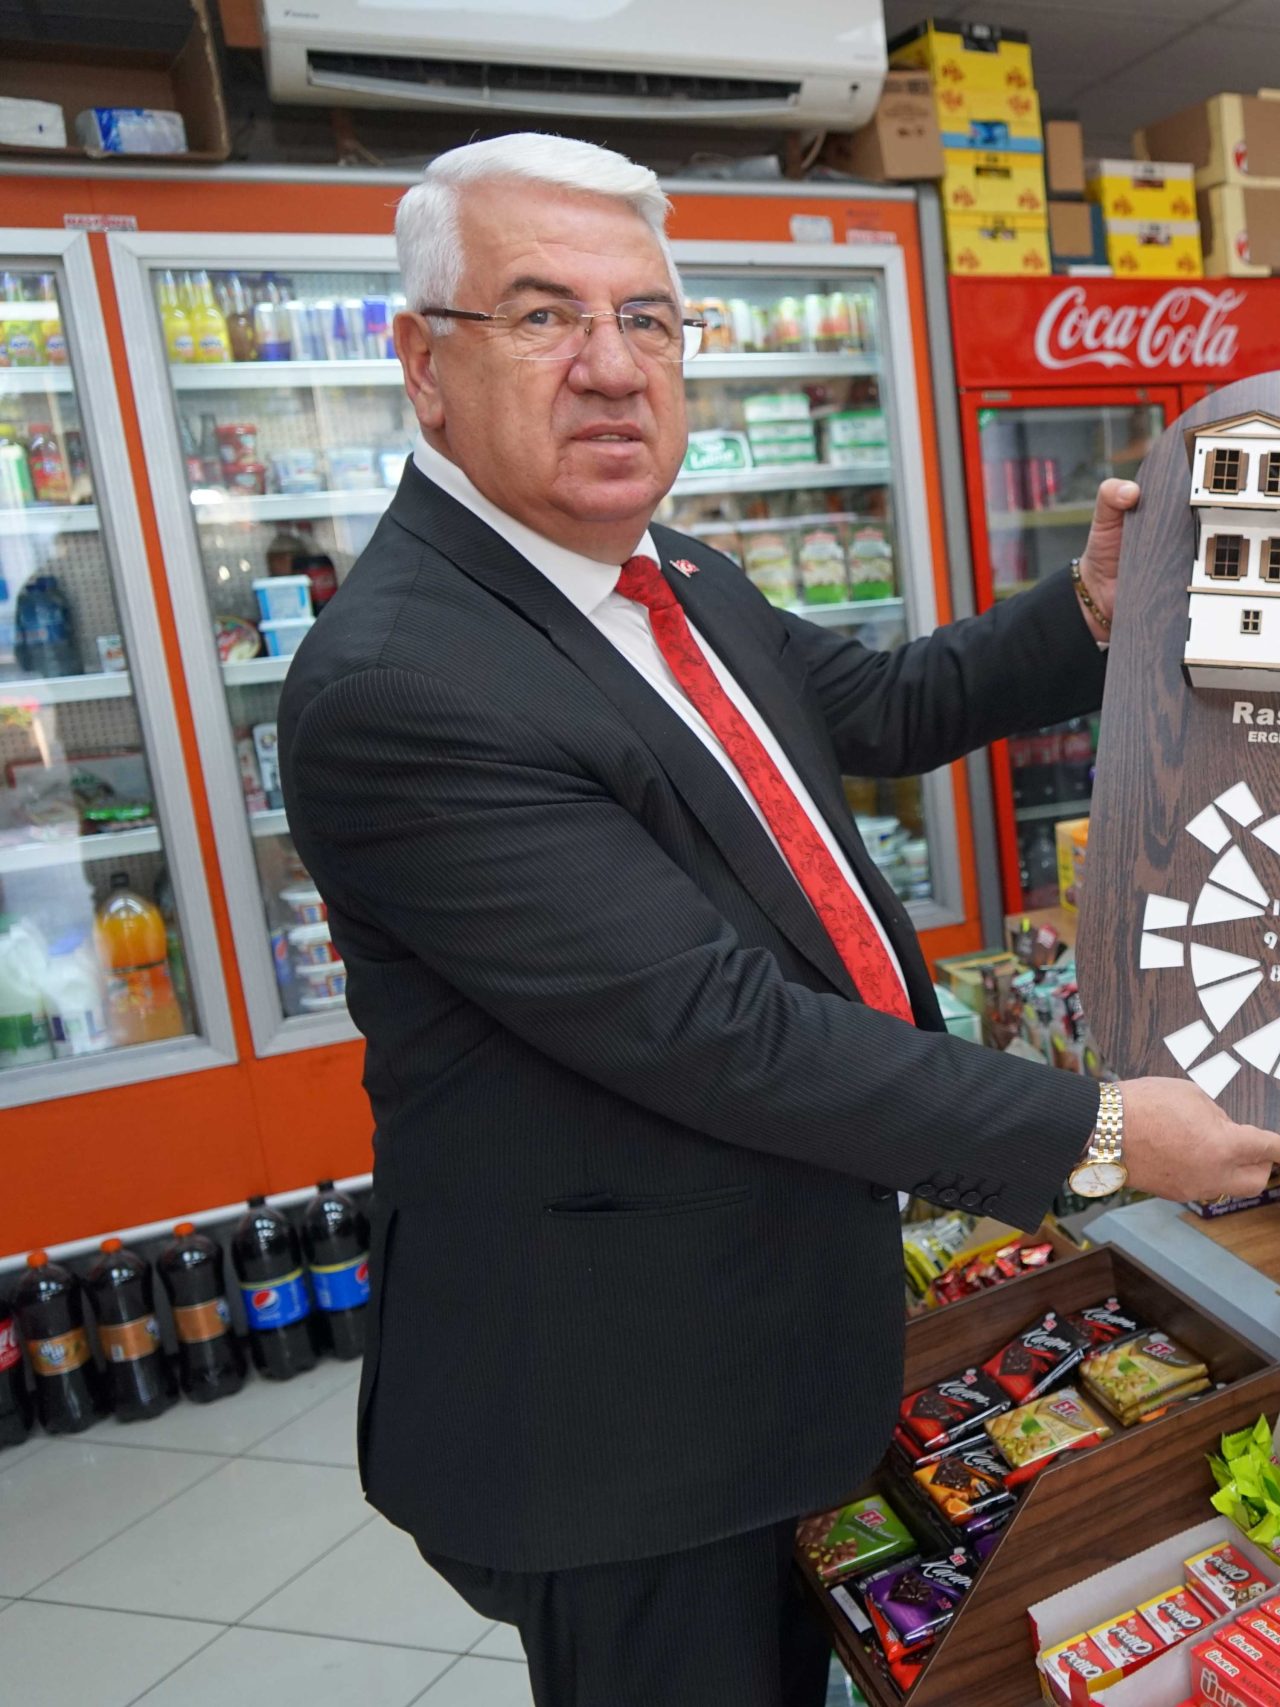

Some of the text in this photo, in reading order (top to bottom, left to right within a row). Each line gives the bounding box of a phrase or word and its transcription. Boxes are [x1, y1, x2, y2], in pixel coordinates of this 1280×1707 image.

[1263, 931, 1278, 950] 9
[1229, 1634, 1262, 1660] ÜLKER
[1205, 1650, 1240, 1677] ÜLKER
